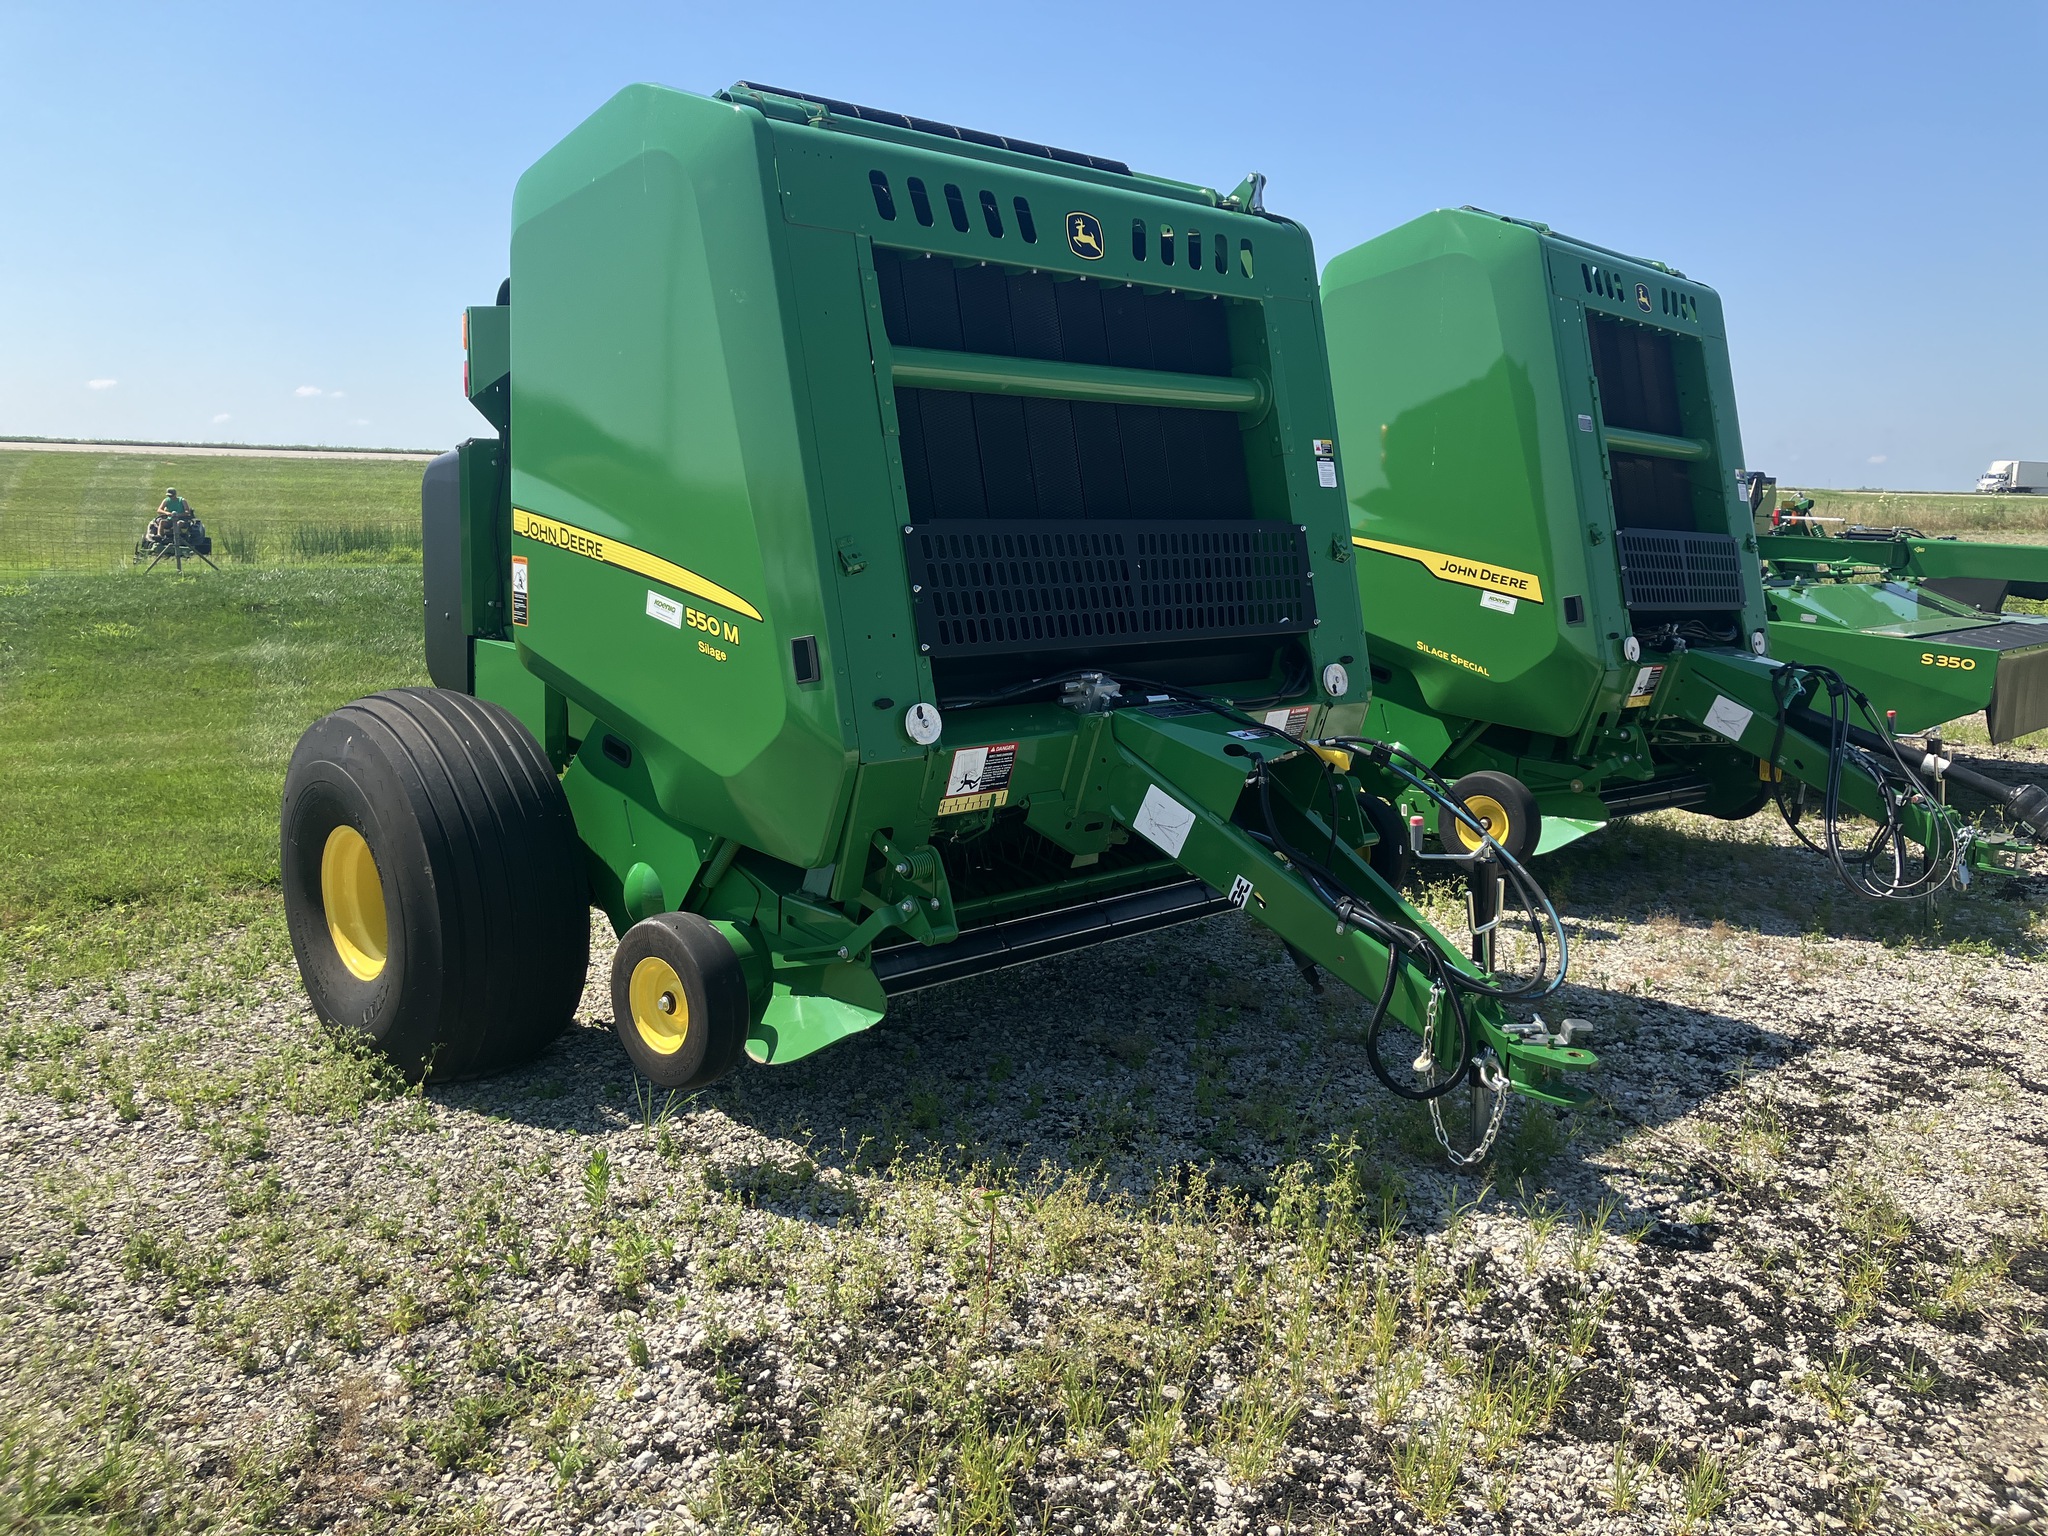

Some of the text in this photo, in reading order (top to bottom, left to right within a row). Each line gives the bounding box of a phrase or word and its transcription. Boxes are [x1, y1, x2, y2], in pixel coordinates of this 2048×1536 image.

[523, 517, 603, 558] JOHN DEERE
[1440, 560, 1529, 590] JOHN DEERE
[685, 606, 740, 646] 550 M
[697, 639, 728, 662] Silage
[1416, 640, 1490, 677] SILAGE SPECIAL
[1920, 652, 1976, 670] S 350
[996, 744, 1015, 752] DANGER
